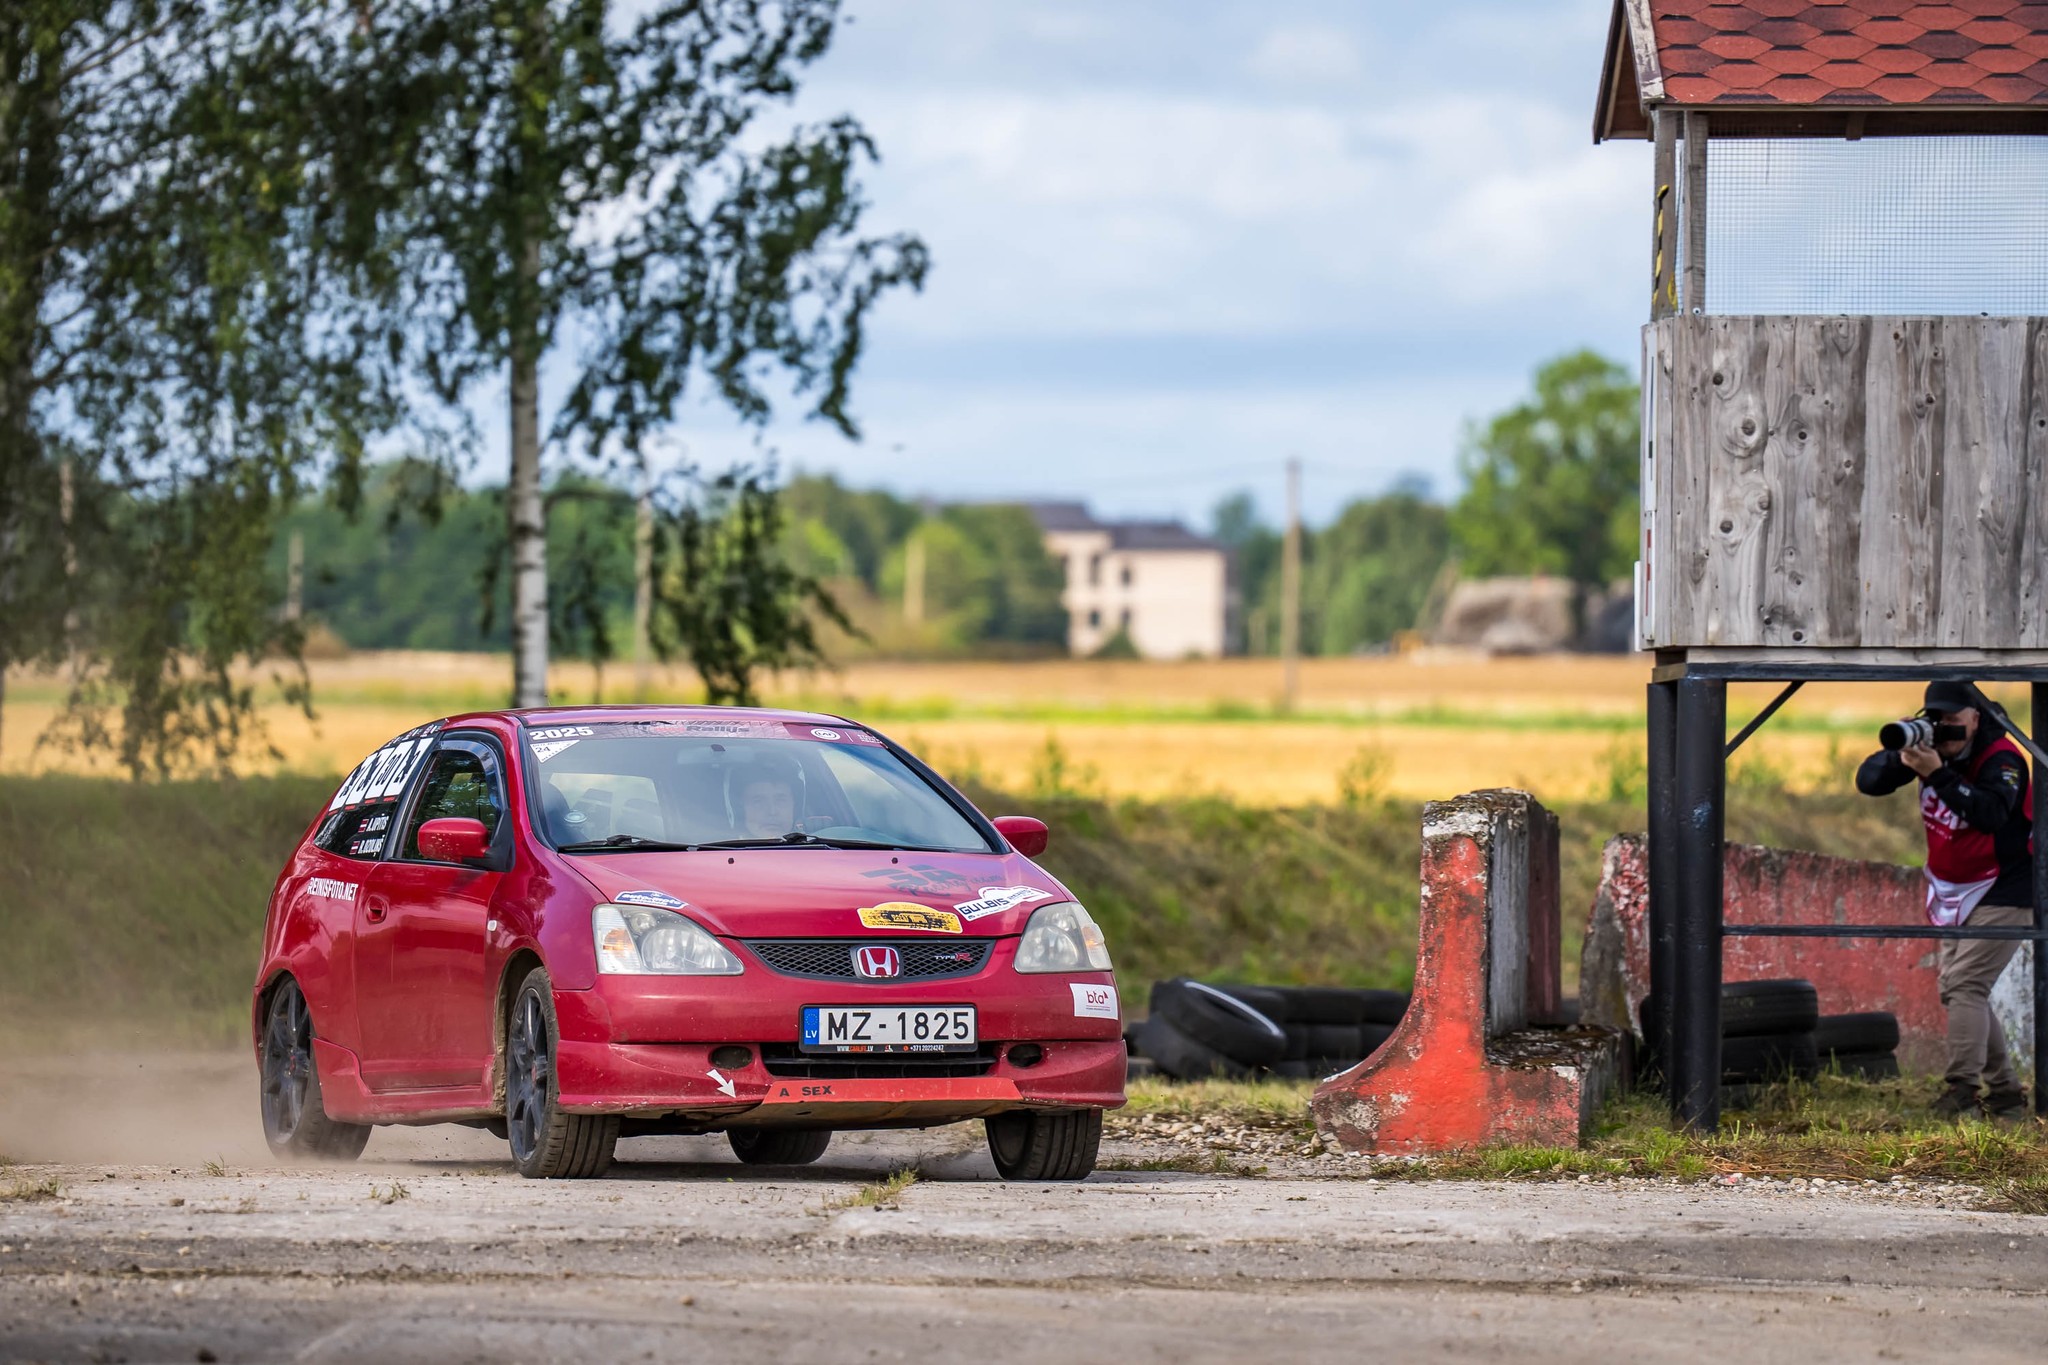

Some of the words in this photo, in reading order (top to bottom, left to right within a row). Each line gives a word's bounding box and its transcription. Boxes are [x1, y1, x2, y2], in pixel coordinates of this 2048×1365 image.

[530, 726, 594, 740] 2025
[959, 898, 1010, 915] GULBIS
[1086, 990, 1108, 1005] bta
[805, 1030, 817, 1038] LV
[779, 1087, 790, 1097] A
[801, 1085, 832, 1096] SEX
